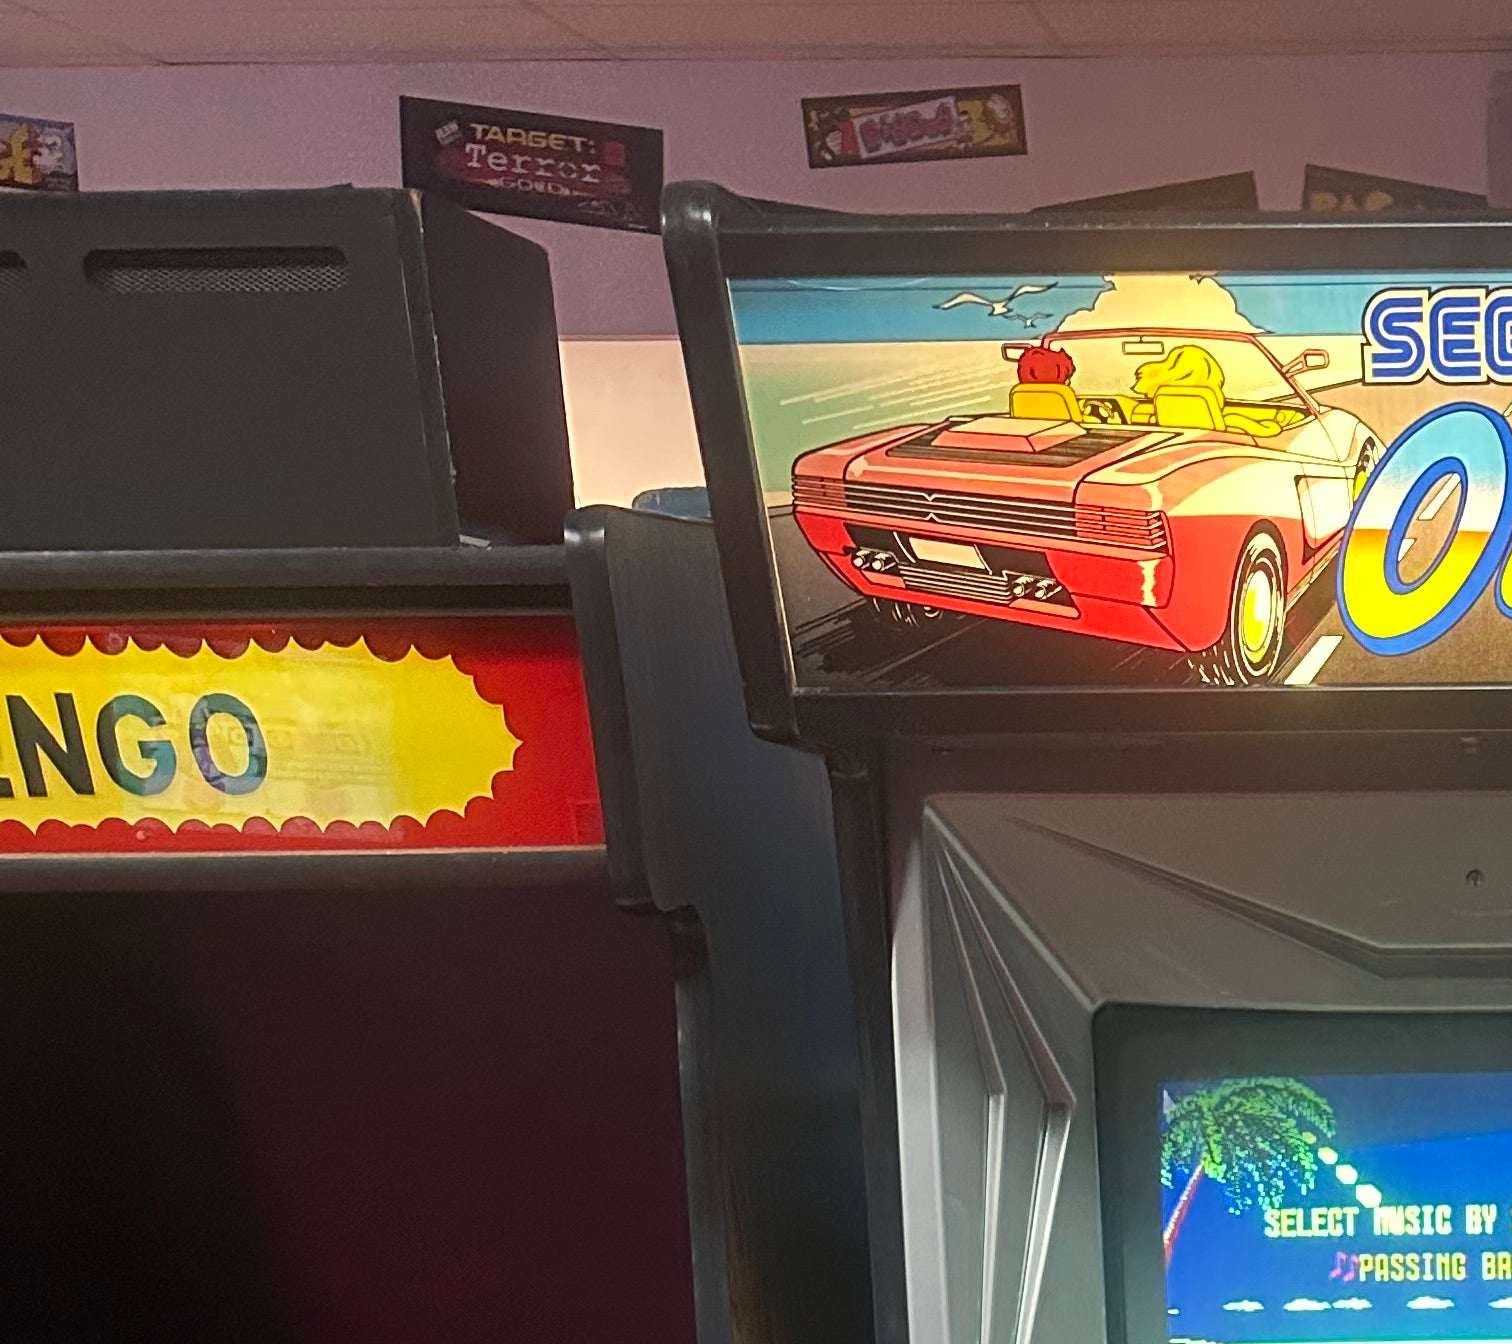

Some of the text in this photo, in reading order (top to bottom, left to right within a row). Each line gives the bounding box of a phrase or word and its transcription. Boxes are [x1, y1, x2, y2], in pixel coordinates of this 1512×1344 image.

[469, 123, 596, 154] TARGET:
[465, 143, 601, 183] Terror
[0, 692, 268, 798] NGO
[1264, 1205, 1359, 1238] SELECT
[1373, 1204, 1452, 1236] MUSIC
[1465, 1204, 1497, 1235] BY
[1358, 1251, 1467, 1282] PASSING
